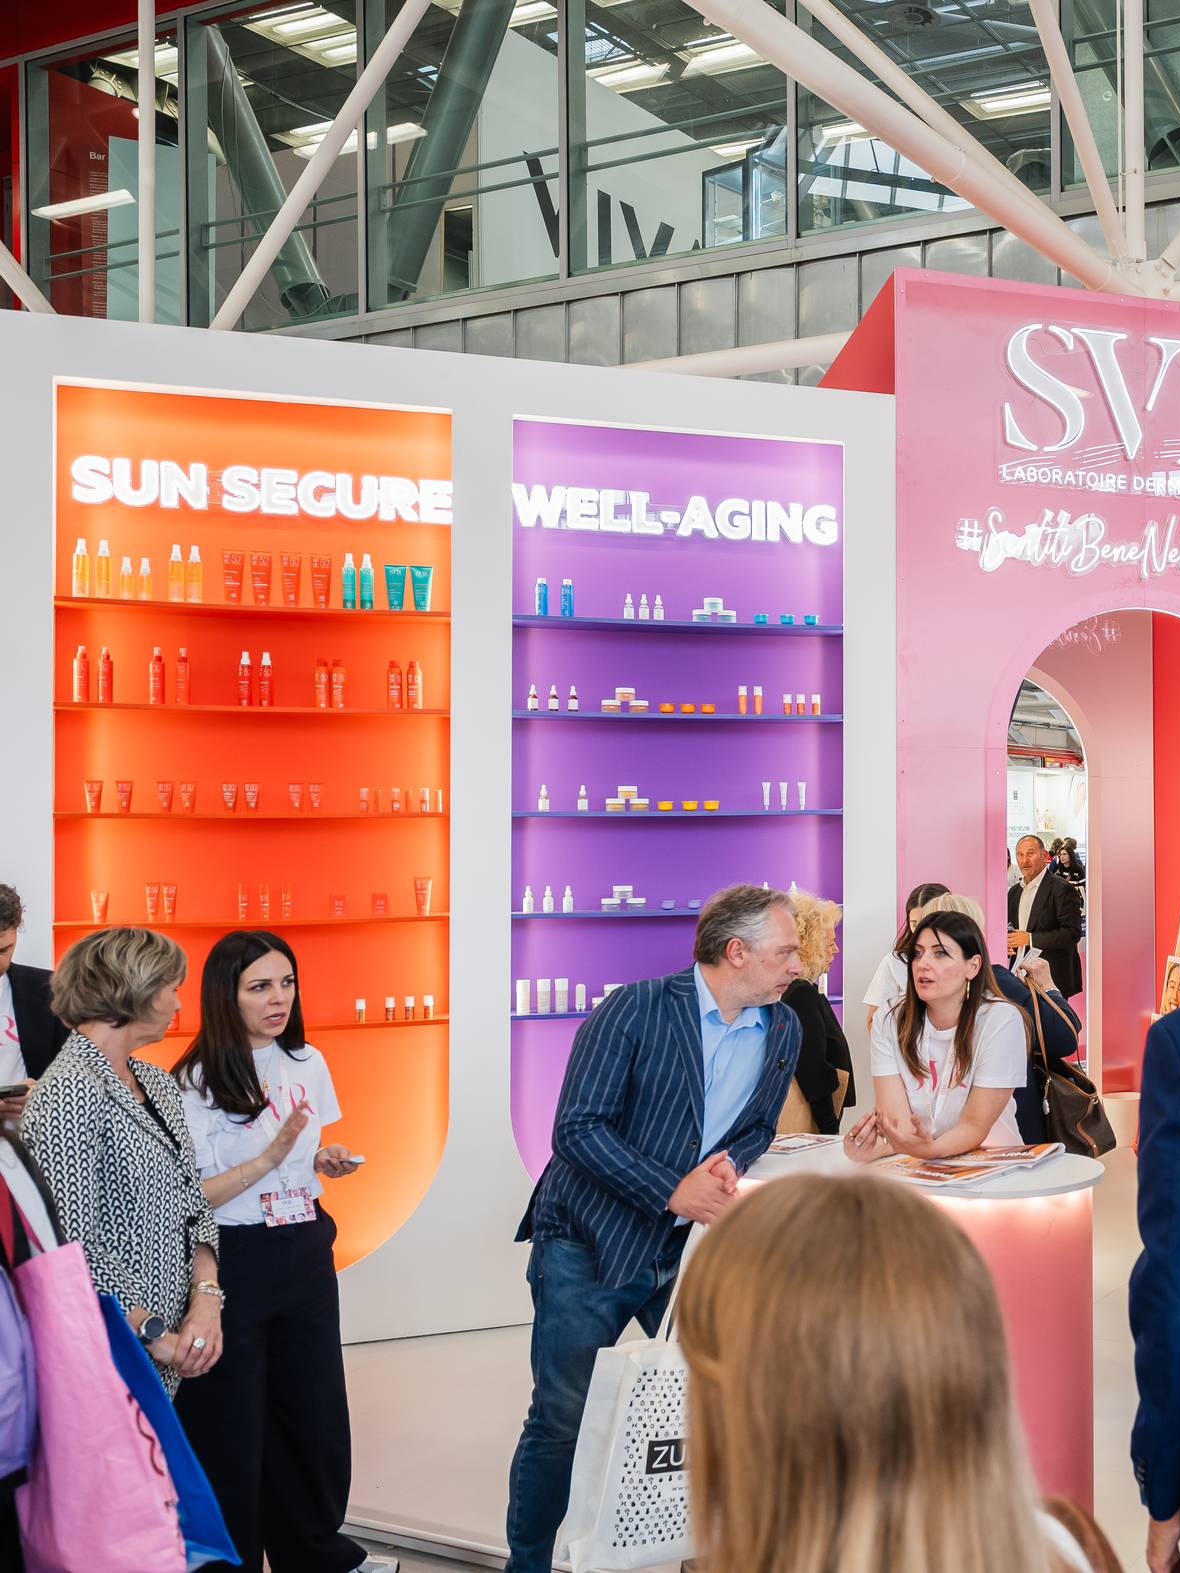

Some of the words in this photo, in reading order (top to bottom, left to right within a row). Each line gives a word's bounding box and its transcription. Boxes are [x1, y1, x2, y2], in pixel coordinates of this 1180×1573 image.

[89, 151, 106, 161] Bar
[71, 454, 209, 511] SUN
[1002, 465, 1128, 491] LABORATOIRE
[512, 482, 838, 546] WELL-AGING
